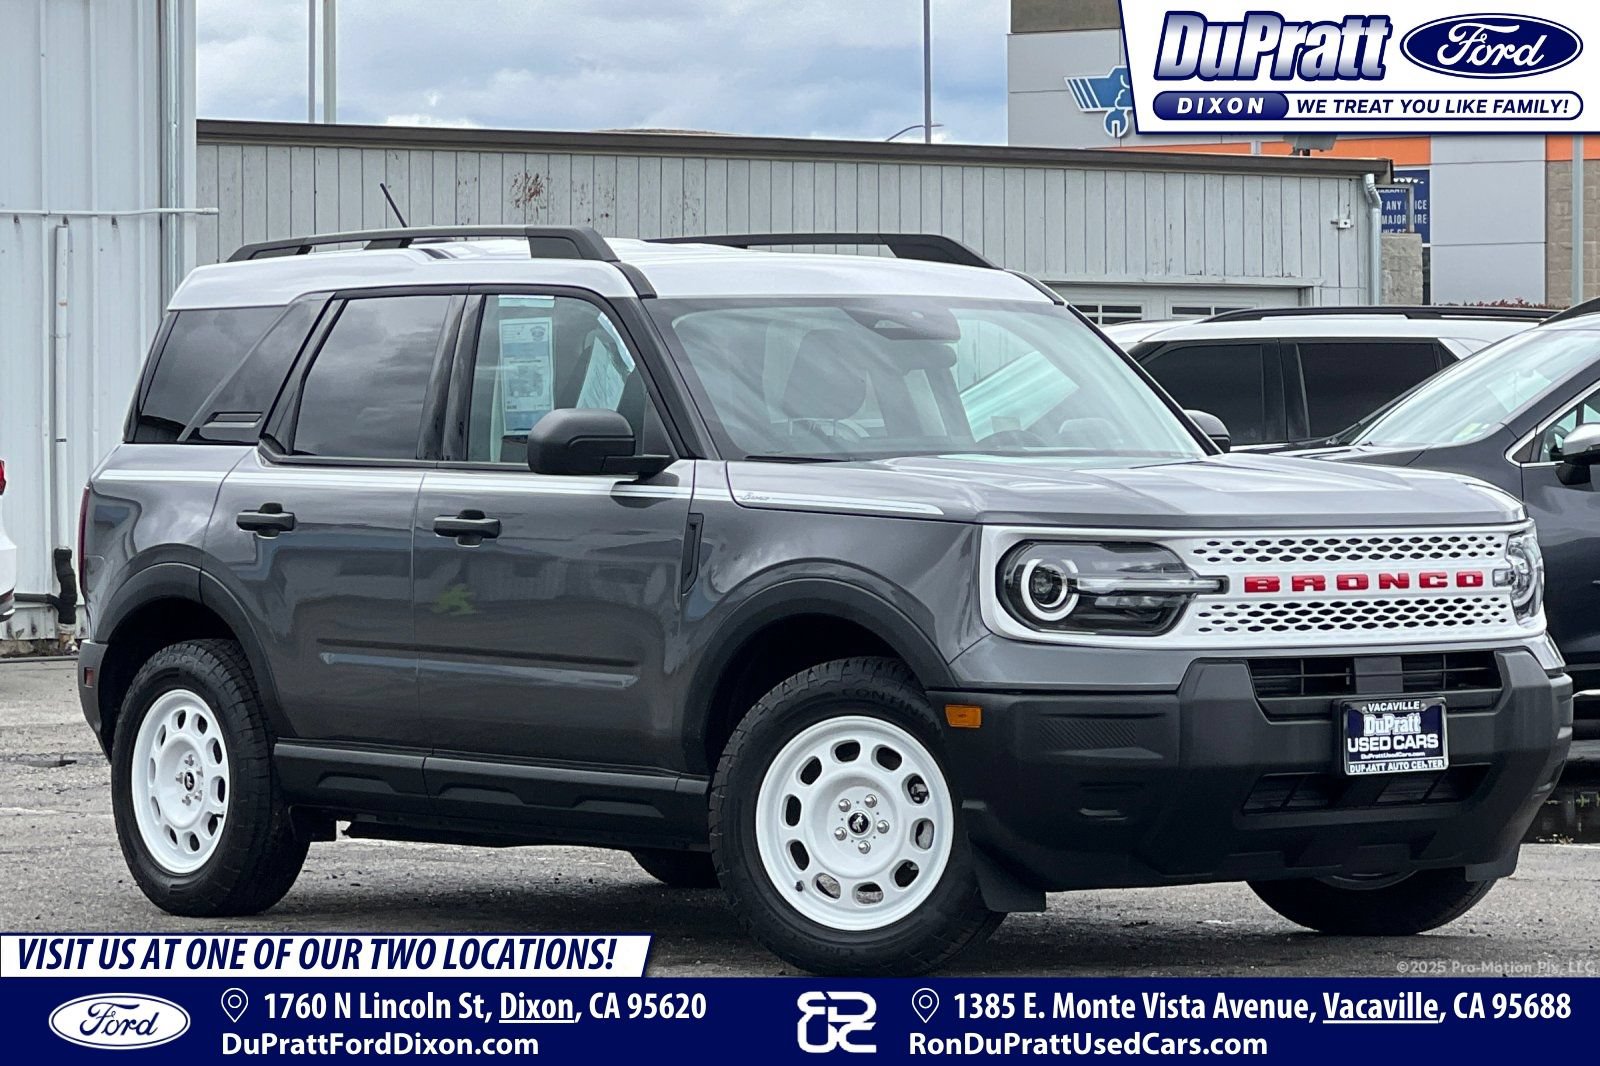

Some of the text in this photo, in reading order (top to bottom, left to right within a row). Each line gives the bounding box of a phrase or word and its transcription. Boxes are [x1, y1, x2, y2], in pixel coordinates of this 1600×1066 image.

[1386, 200, 1401, 210] ANY
[1381, 214, 1407, 225] MAJOR
[1244, 570, 1484, 593] BRONCO
[1367, 700, 1421, 712] VACAVILLE
[1363, 712, 1422, 736] DuPratt
[1347, 733, 1439, 753] USED CARS
[1387, 761, 1410, 771] AUTO
